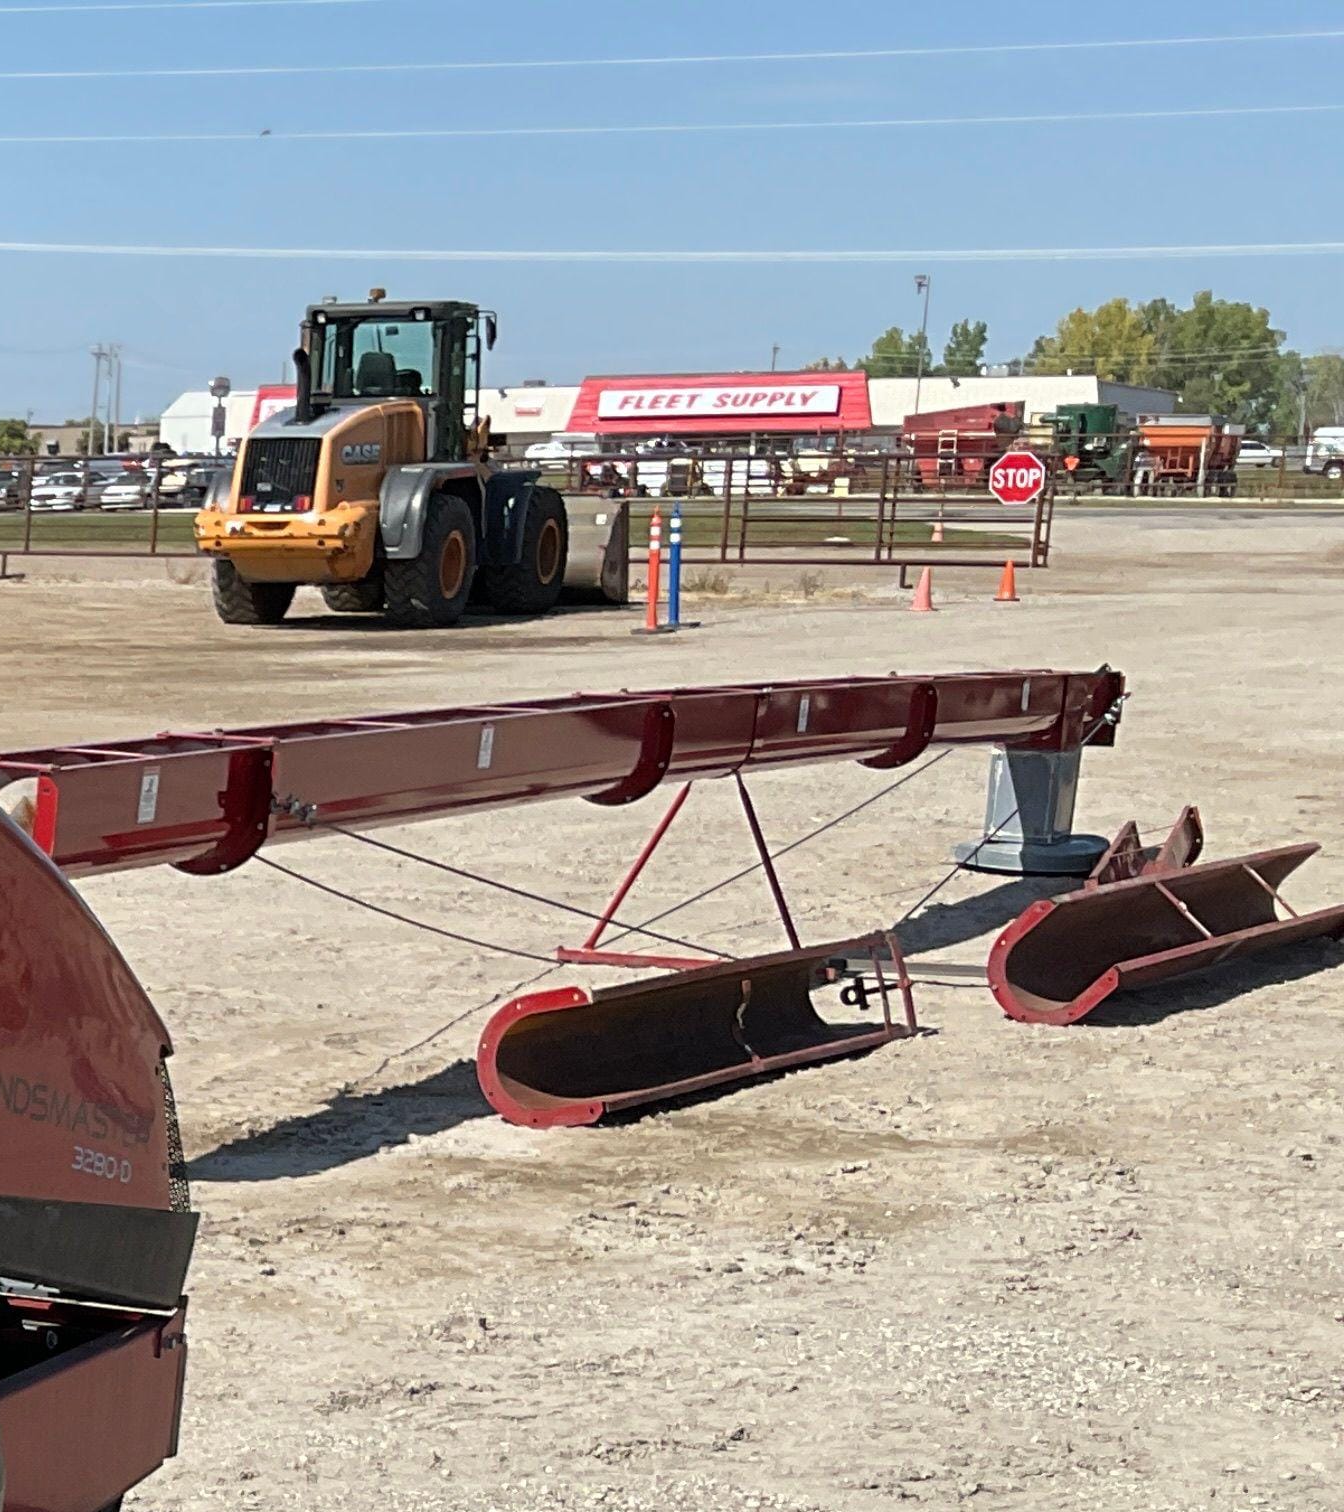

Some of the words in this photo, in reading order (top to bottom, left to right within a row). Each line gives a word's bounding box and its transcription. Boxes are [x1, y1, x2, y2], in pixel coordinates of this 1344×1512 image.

[618, 393, 702, 410] FLEET
[712, 391, 819, 408] SUPPLY
[341, 444, 381, 465] CASE
[993, 468, 1041, 489] STOP
